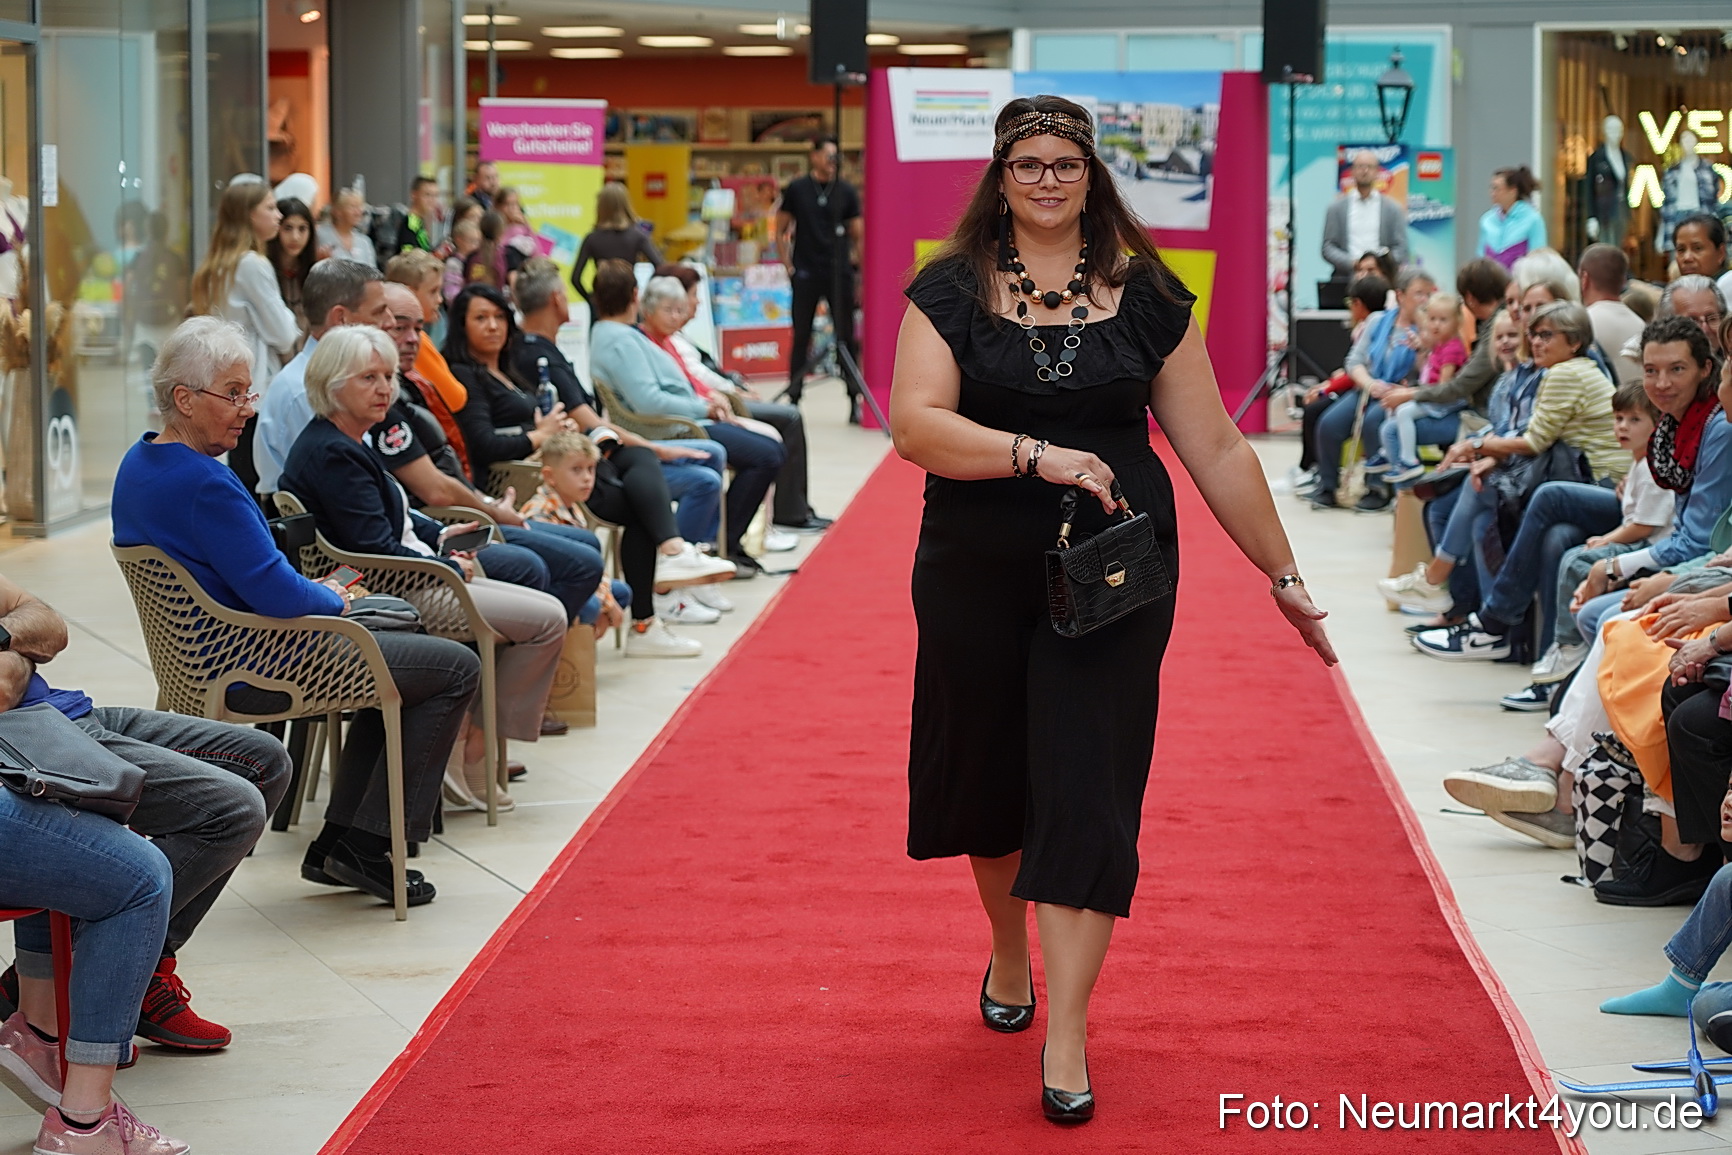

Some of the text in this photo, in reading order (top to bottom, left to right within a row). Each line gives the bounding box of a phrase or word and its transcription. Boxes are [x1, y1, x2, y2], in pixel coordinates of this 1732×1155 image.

[486, 121, 594, 139] Verschenken Sie
[1638, 110, 1732, 154] VE
